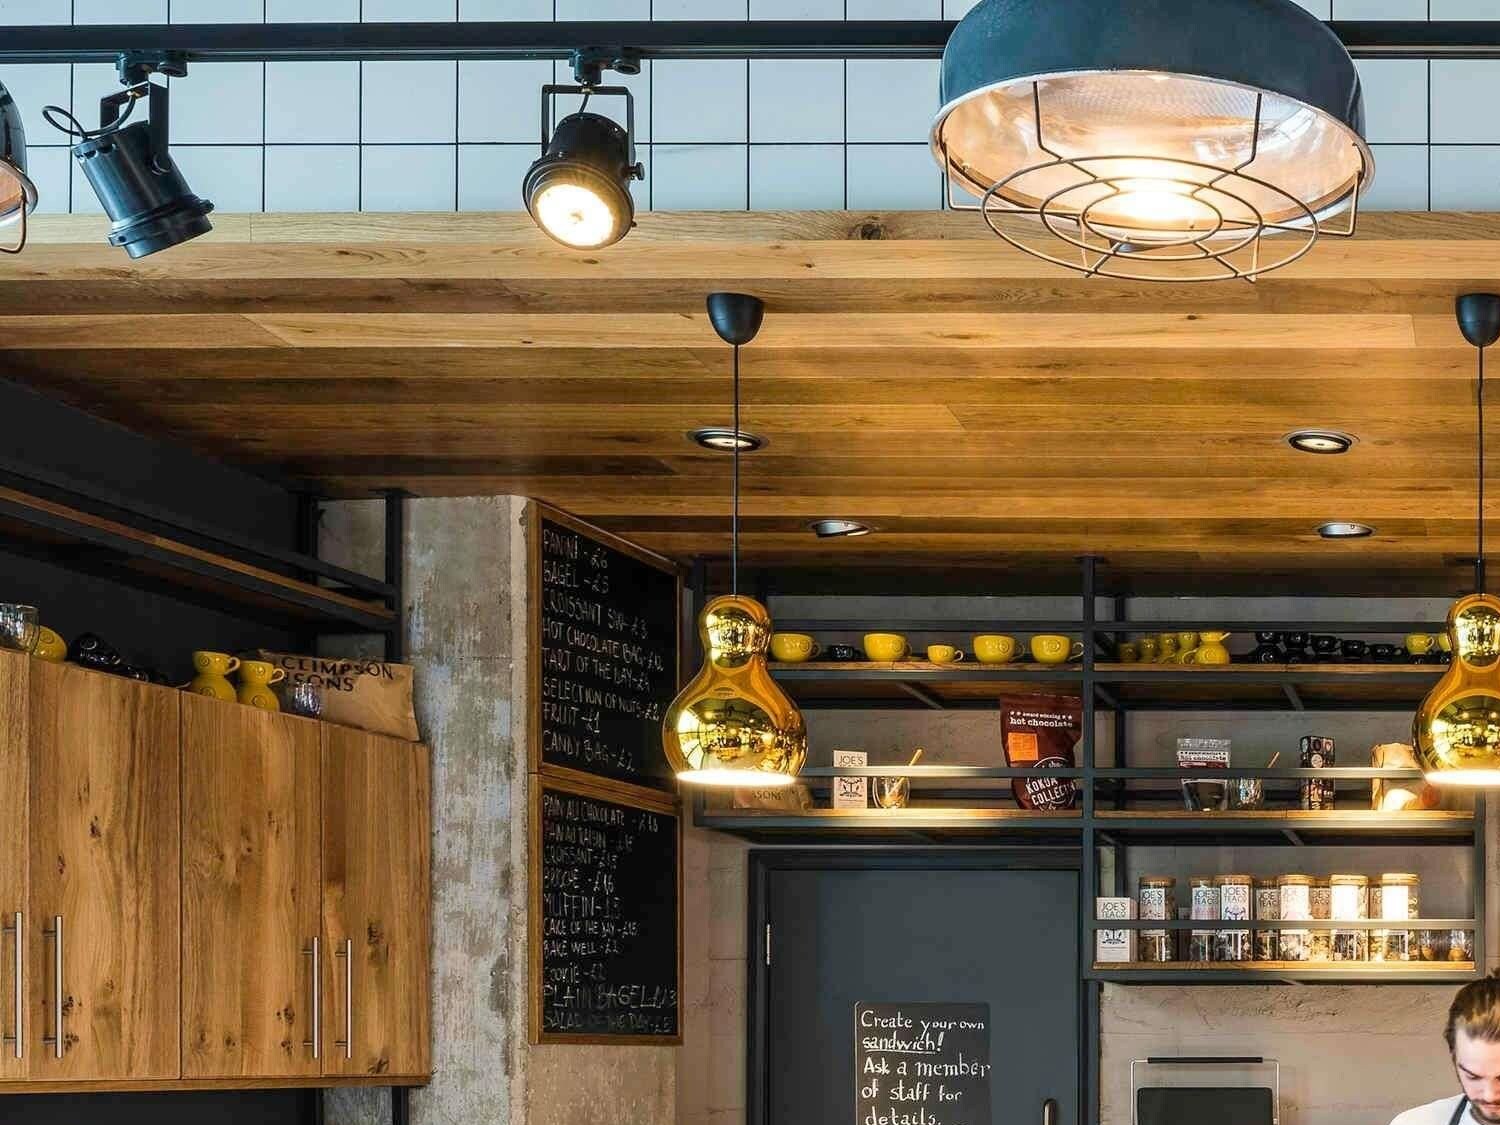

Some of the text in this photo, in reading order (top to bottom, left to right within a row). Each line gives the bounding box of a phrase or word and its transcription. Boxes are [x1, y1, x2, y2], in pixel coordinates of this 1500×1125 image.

[544, 560, 580, 588] BAGEL
[544, 588, 600, 626] CROISSANT
[543, 616, 563, 640] HOT
[567, 624, 618, 657] CHOCOLATE
[282, 657, 393, 680] CLIMPSON
[576, 656, 589, 672] OF
[592, 658, 611, 679] THE
[544, 677, 602, 706] SELECTION
[1010, 717, 1072, 727] hot chocolate
[861, 1010, 984, 1040] Create your own
[863, 1032, 944, 1051] sandwich!
[864, 1053, 990, 1077] Ask a member
[862, 1079, 962, 1101] of staff for
